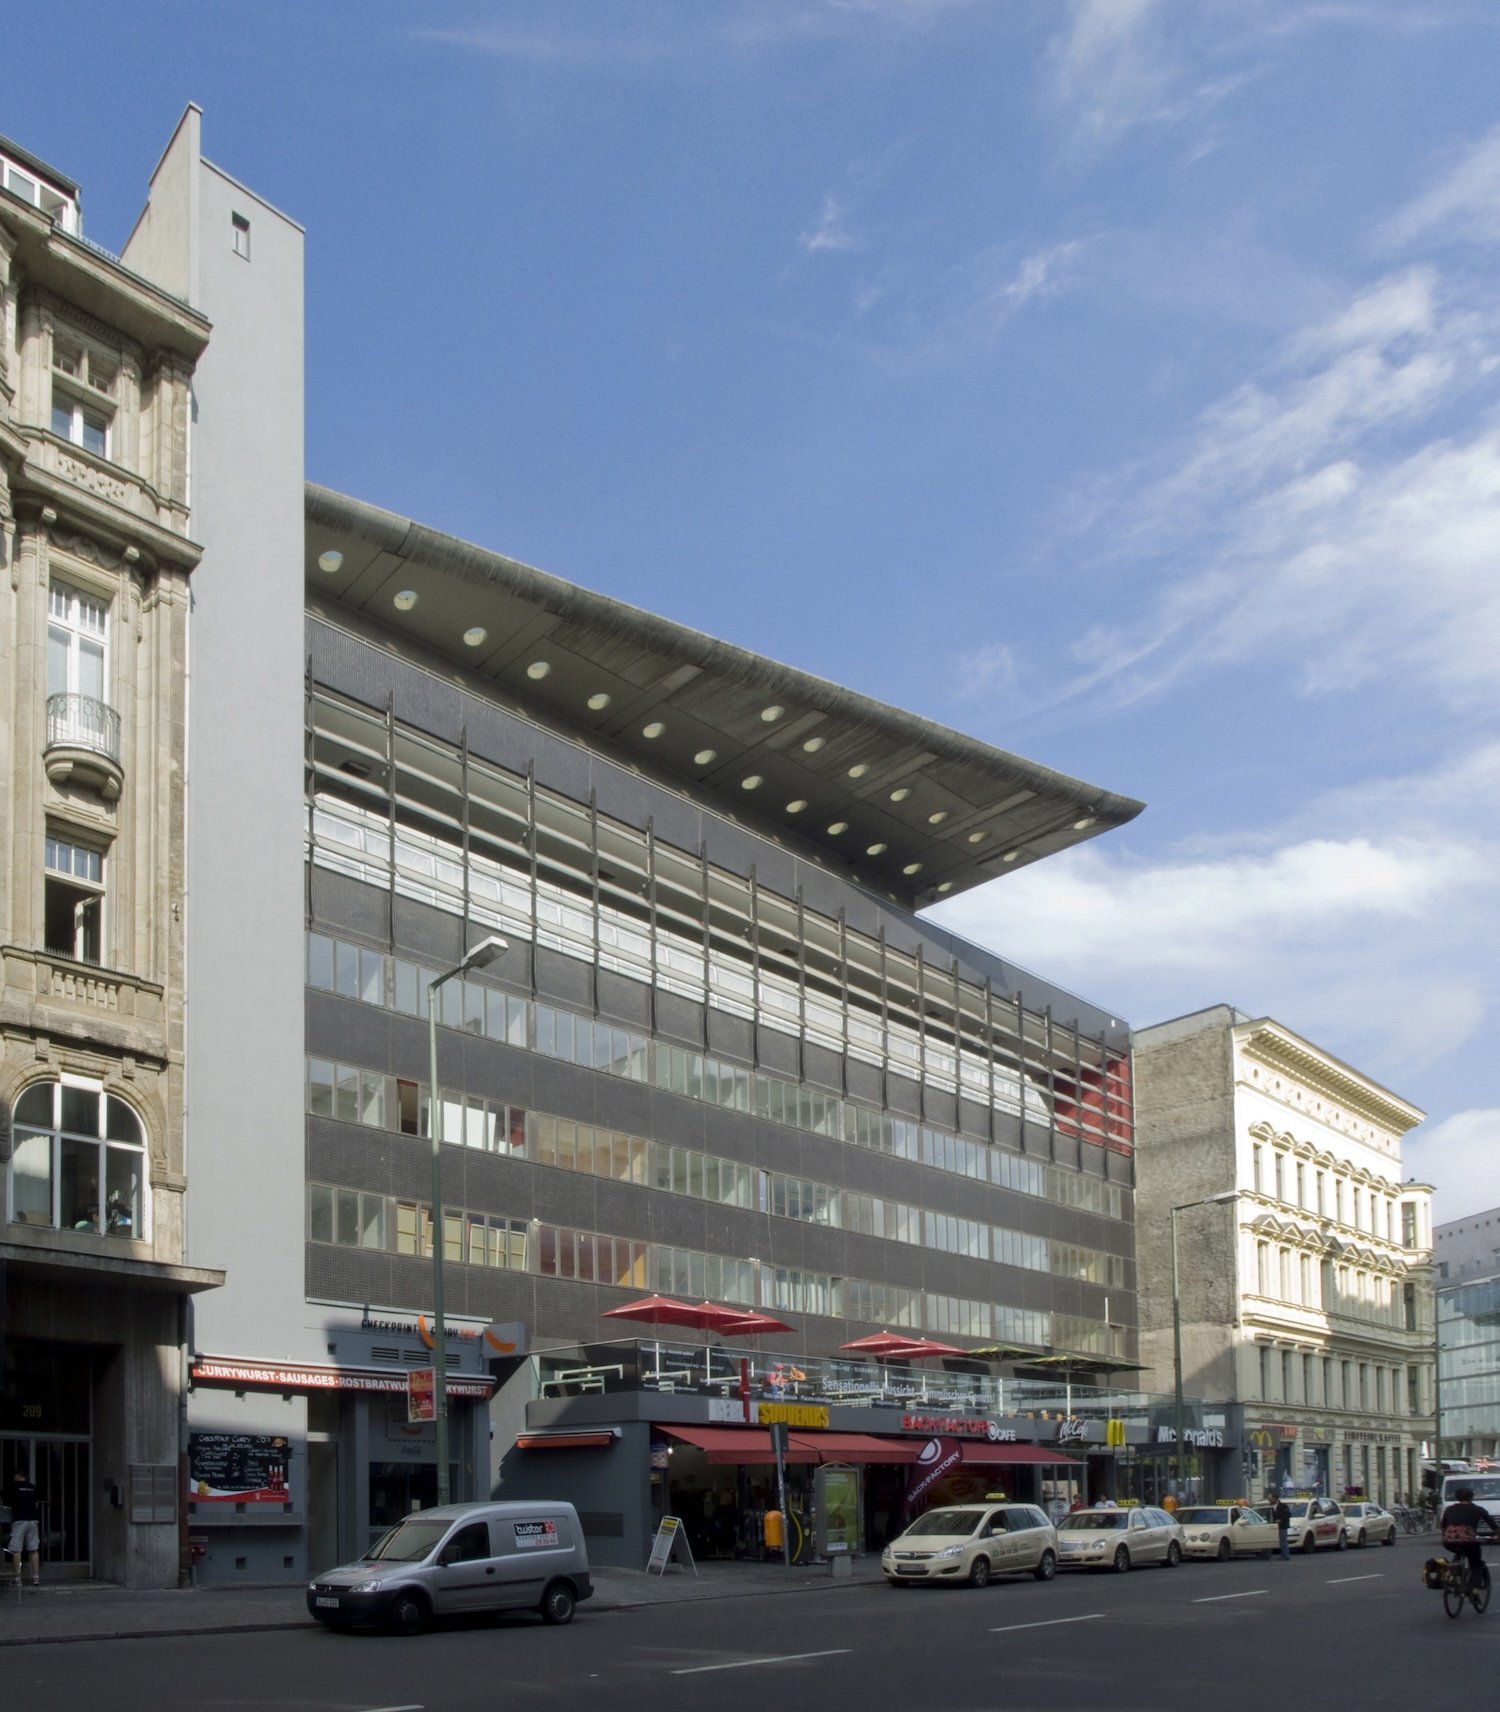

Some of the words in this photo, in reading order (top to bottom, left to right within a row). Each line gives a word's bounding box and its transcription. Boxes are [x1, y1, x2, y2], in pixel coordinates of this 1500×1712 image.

[361, 1319, 418, 1333] CHECKPOINT
[198, 1365, 276, 1380] CURRYWURST
[279, 1373, 335, 1386] SAUSAGES
[446, 1384, 488, 1395] RYWURST
[821, 1376, 880, 1393] Sensationelle
[22, 1404, 42, 1418] 209
[759, 1402, 830, 1428] SOUVENIRS
